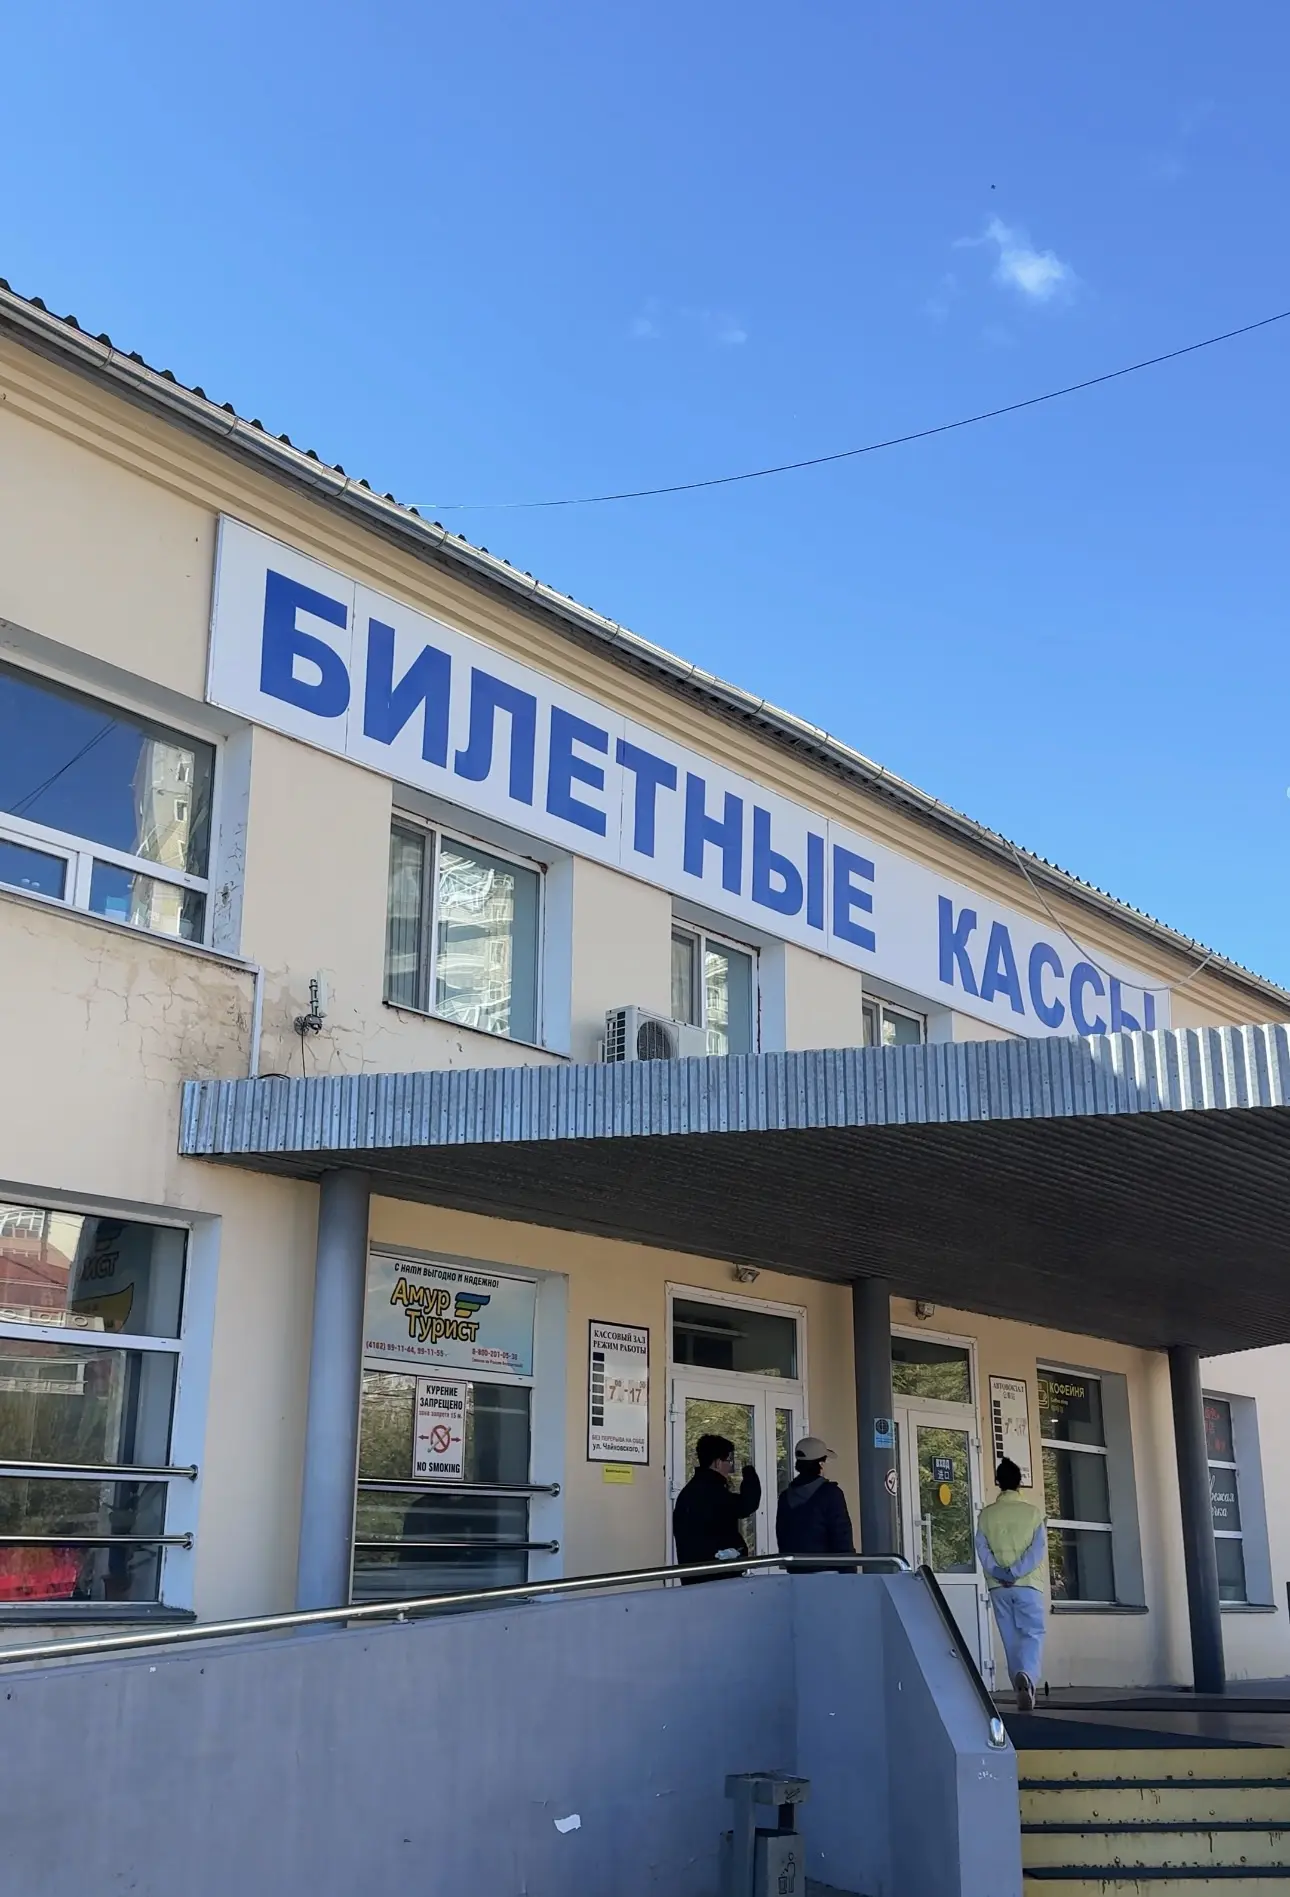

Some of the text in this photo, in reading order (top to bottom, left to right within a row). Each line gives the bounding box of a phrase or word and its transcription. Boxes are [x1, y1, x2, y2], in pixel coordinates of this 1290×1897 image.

[260, 569, 1156, 1037] БИЛЕТНЫЕ КАССЫ
[394, 1262, 500, 1288] С НАМИ ВЫГОДНО И НАДЕЖНО!
[390, 1277, 451, 1315] Амур
[405, 1308, 480, 1344] Турист
[594, 1330, 646, 1344] КАССОВЫЙ ЗАЛ
[593, 1340, 646, 1354] РЕЖИМ РАБОТЫ
[426, 1385, 458, 1396] КУРЕНИЕ
[1050, 1382, 1084, 1398] КОФЕЙНЯ
[420, 1398, 462, 1410] ЗАПРЕЩЕНО
[417, 1462, 460, 1473] NO SMOKING
